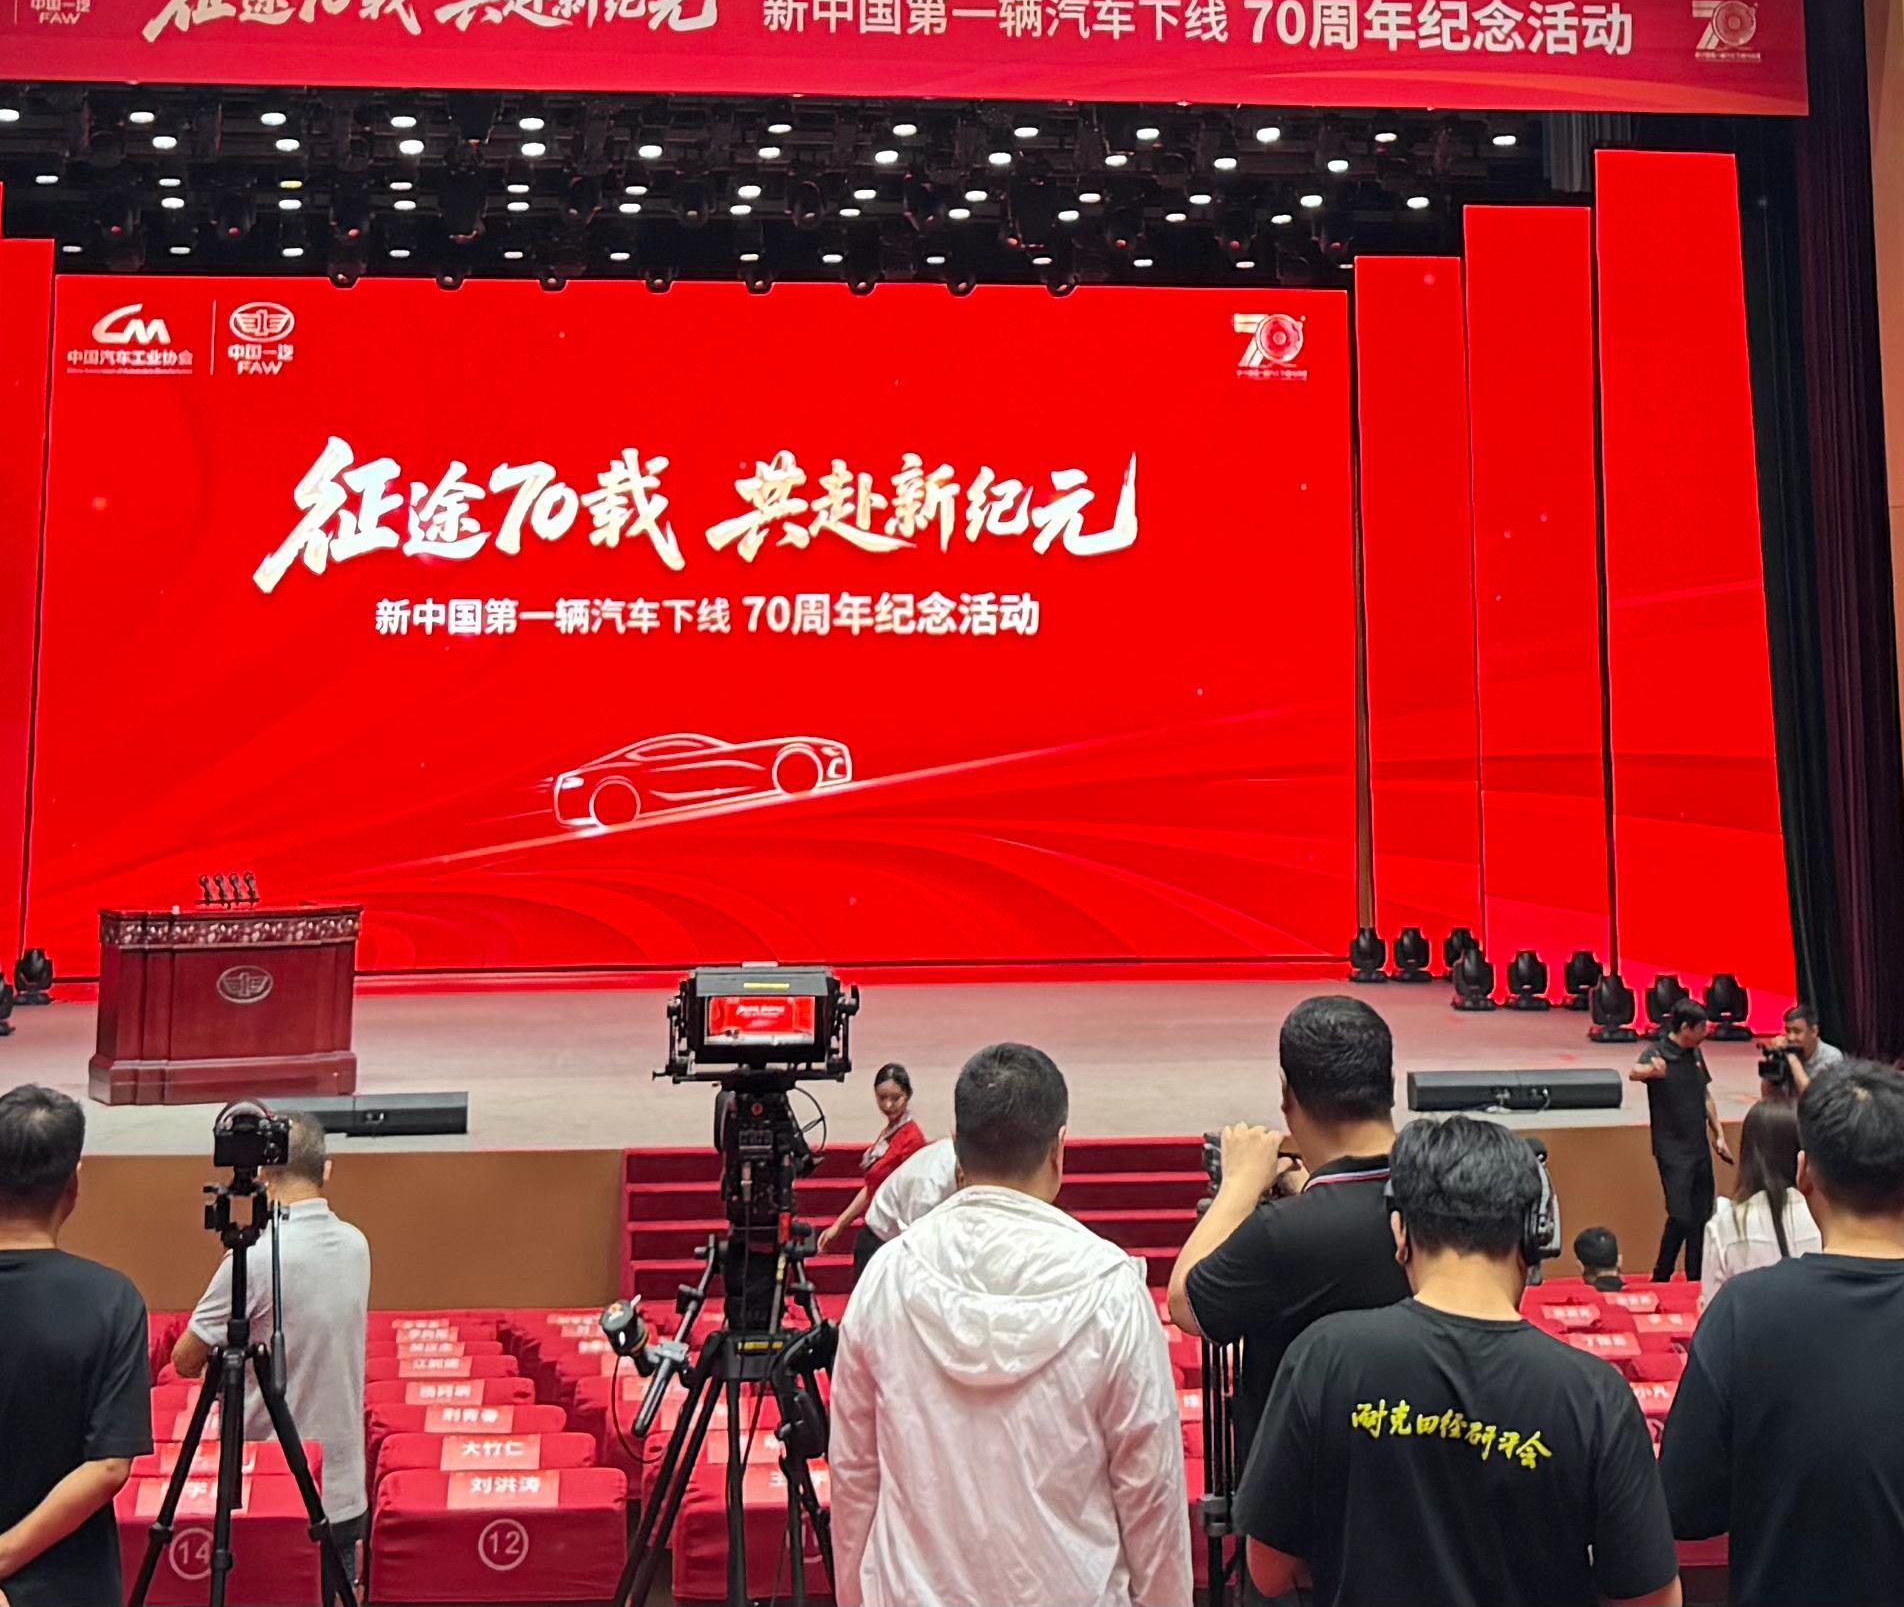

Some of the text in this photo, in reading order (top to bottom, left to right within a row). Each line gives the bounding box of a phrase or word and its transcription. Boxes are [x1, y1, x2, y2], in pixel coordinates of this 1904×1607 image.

[39, 12, 80, 25] FAW
[67, 349, 193, 366] 中国汽车工业协会
[237, 361, 282, 375] FAW
[252, 436, 1138, 593] 征途70载 共赴新纪元
[375, 591, 1040, 636] 新中国第一辆汽车下线 70周年纪念活动
